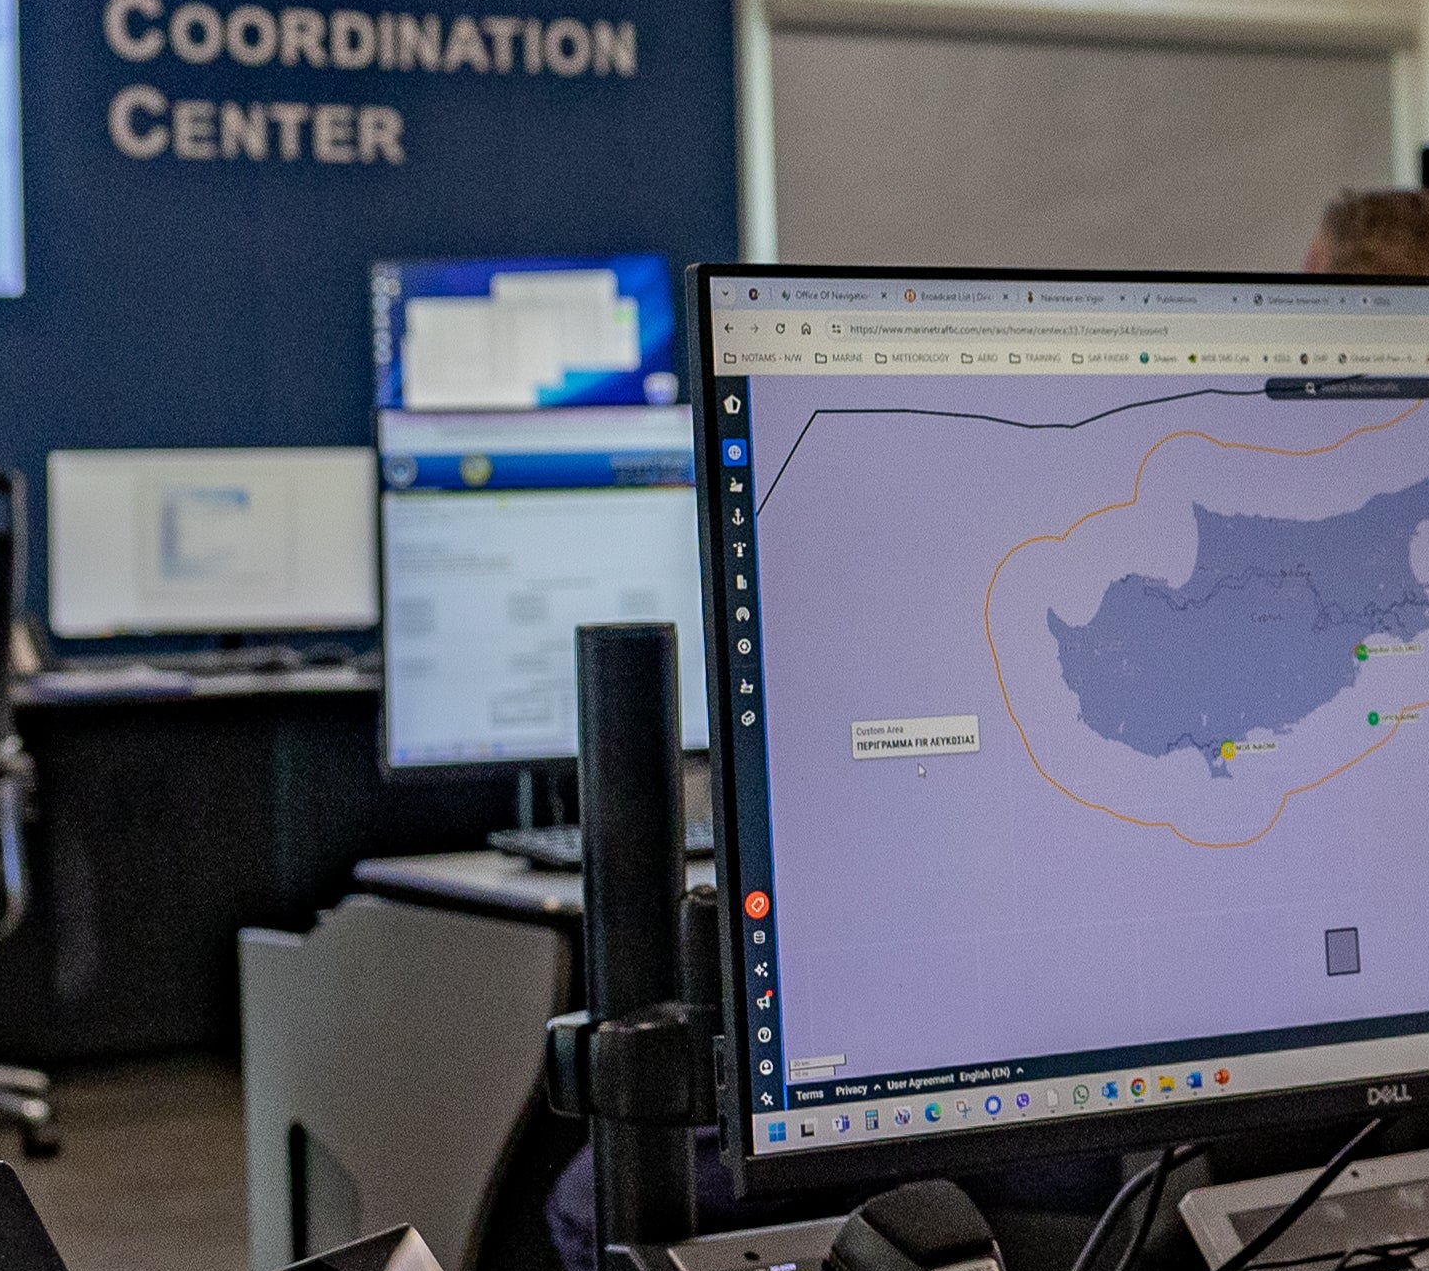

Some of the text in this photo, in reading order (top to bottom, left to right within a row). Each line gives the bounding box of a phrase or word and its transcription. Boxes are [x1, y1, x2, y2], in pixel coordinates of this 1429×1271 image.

[107, 84, 407, 166] CENTER
[795, 291, 818, 301] Office
[820, 291, 830, 301] Of
[921, 292, 956, 302] Broadcast
[958, 292, 972, 302] List
[741, 353, 777, 363] NOTAMS
[784, 353, 802, 363] N/W
[832, 353, 863, 363] MARINE
[892, 353, 949, 363] METEOROLOGY
[977, 354, 998, 363] AERO
[1025, 354, 1061, 363] TRAINING
[856, 726, 904, 736] Custom Area
[857, 739, 913, 751] ΠΕΡΙΓΡΑΜΜΑ
[915, 738, 928, 747] FIR
[959, 1066, 1011, 1082] English (EN)
[887, 1073, 954, 1091] User Agreement
[796, 1089, 824, 1101] Terms
[835, 1084, 868, 1097] Privacy
[1367, 1083, 1412, 1106] DELL
